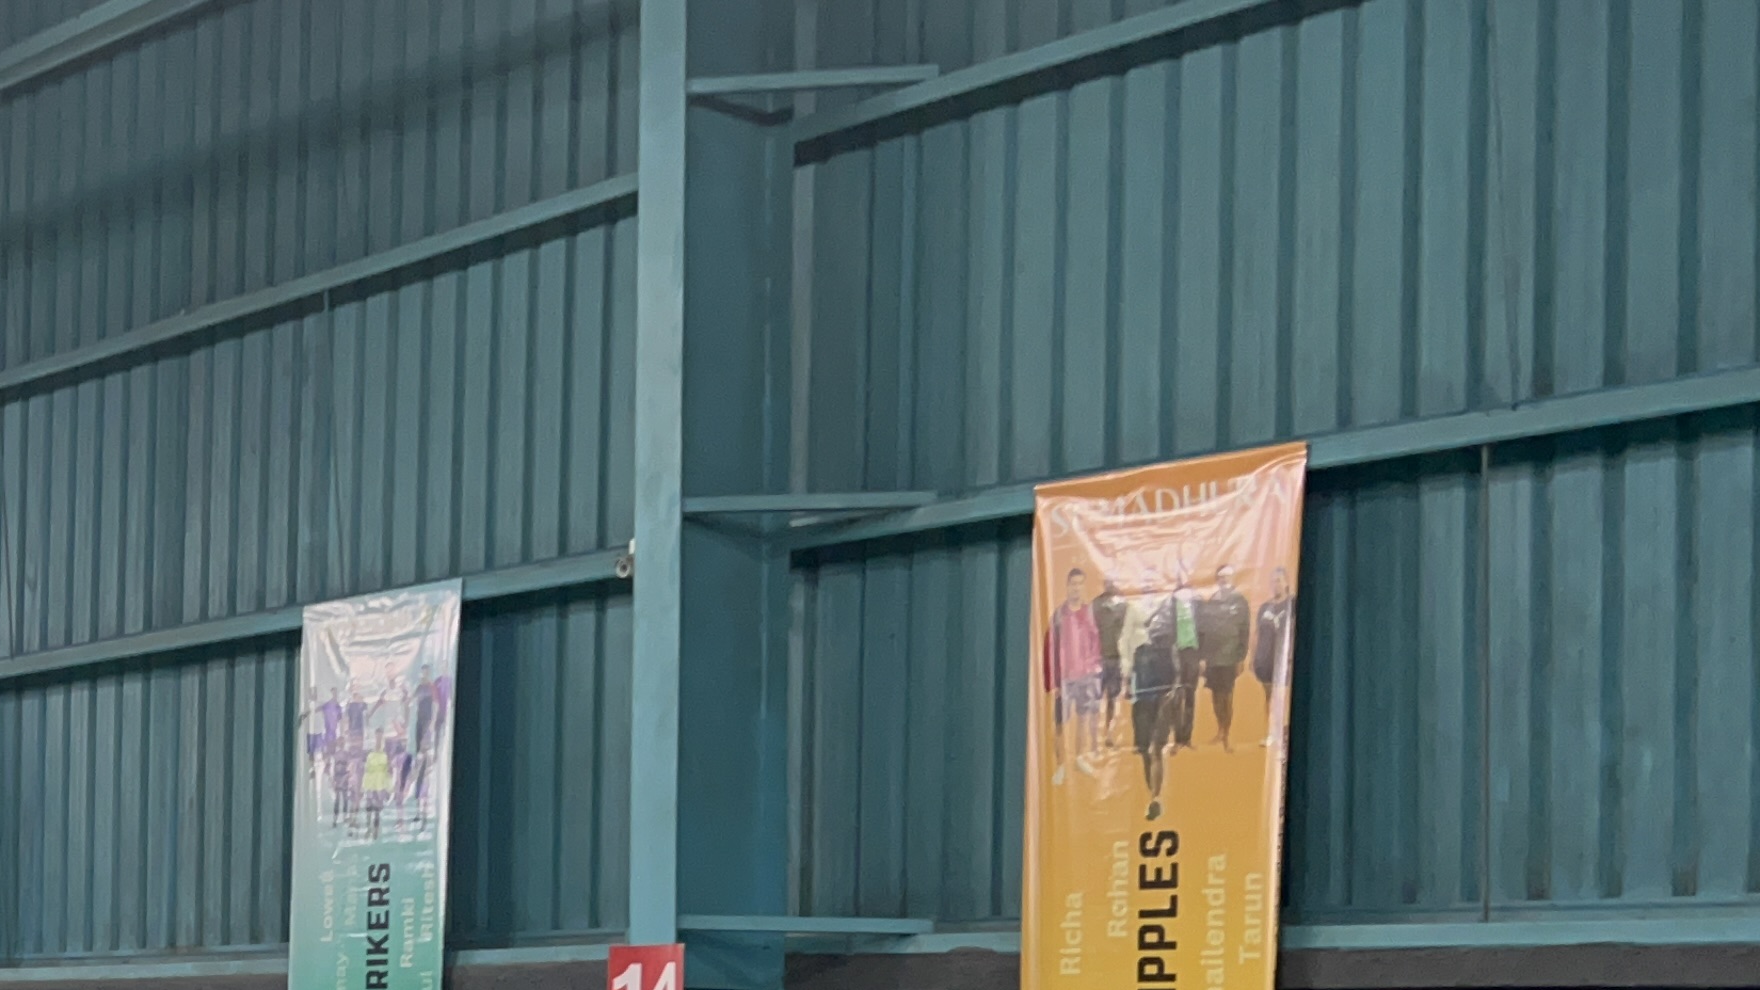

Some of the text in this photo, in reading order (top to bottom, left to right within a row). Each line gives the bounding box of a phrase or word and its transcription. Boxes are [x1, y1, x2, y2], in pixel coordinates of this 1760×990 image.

[399, 897, 415, 969] Ramki
[1106, 839, 1130, 938] Rohan
[1238, 871, 1264, 964] Tarun
[1059, 891, 1084, 976] Richa
